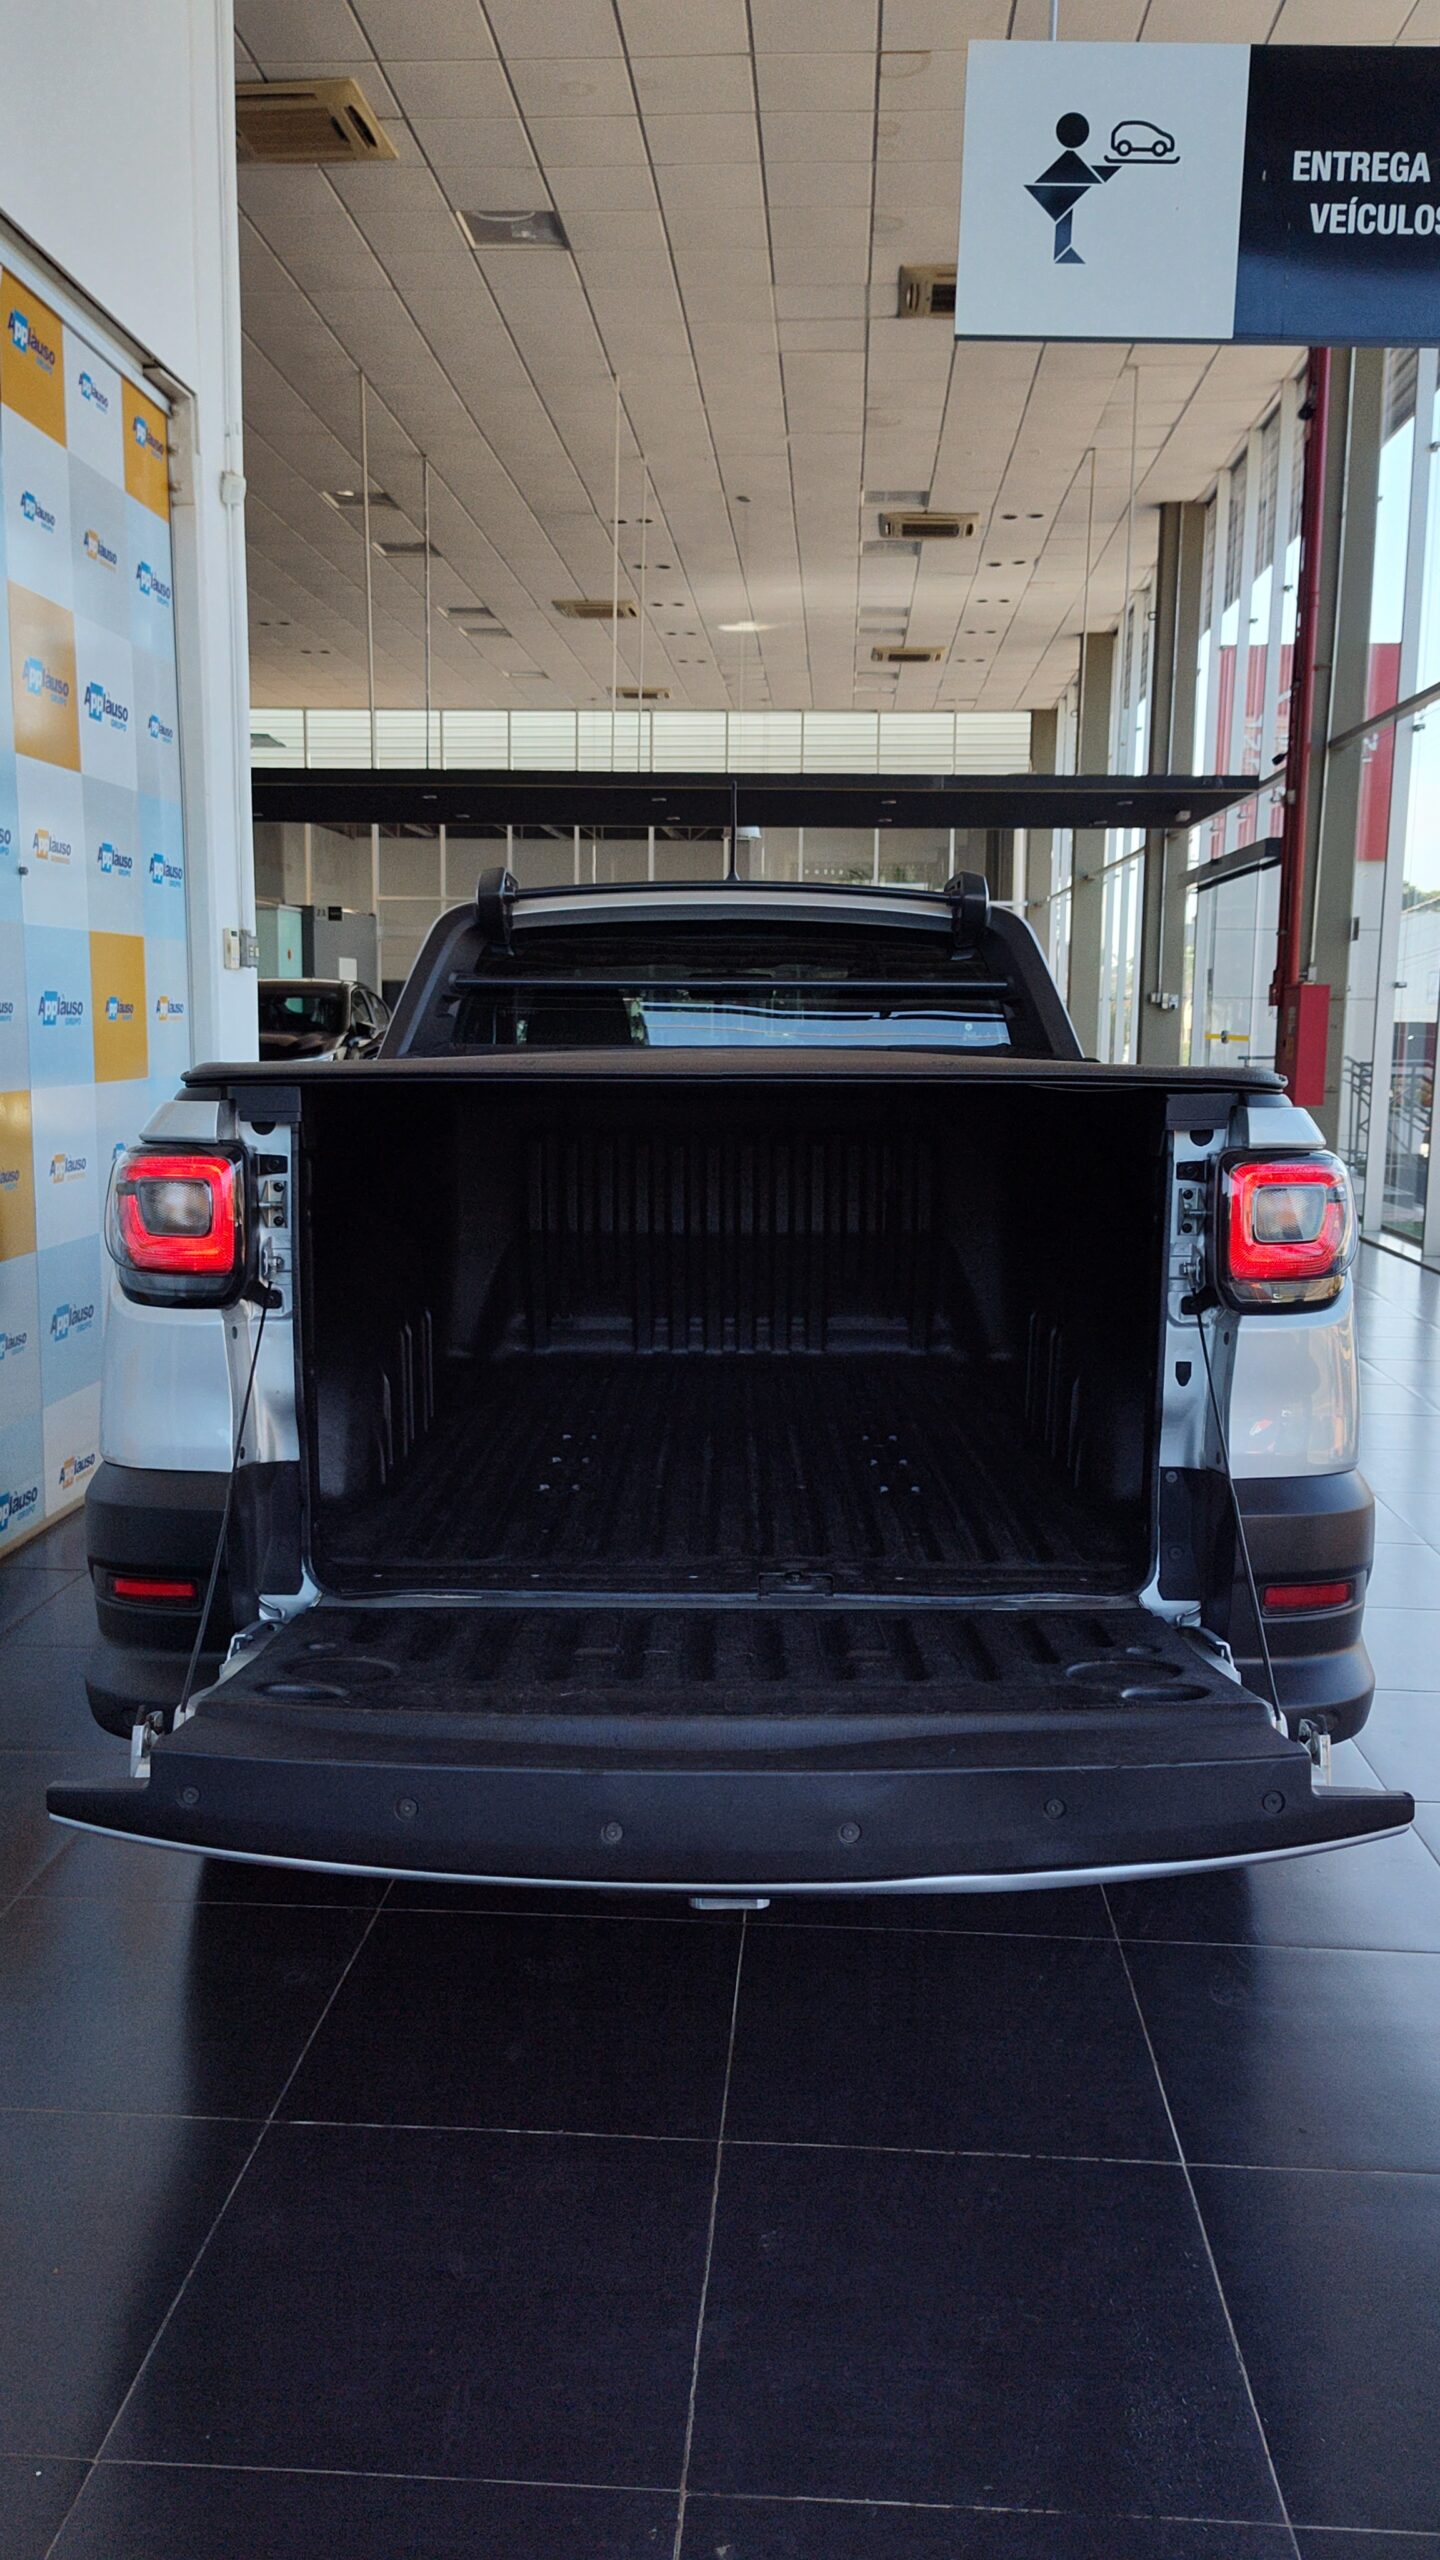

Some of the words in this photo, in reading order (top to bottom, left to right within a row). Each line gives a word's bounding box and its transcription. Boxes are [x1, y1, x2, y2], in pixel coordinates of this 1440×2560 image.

[1293, 151, 1430, 183] ENTREGA
[84, 684, 128, 721] Applauso
[38, 995, 83, 1022] Applauso
[50, 1304, 94, 1337] Applauso
